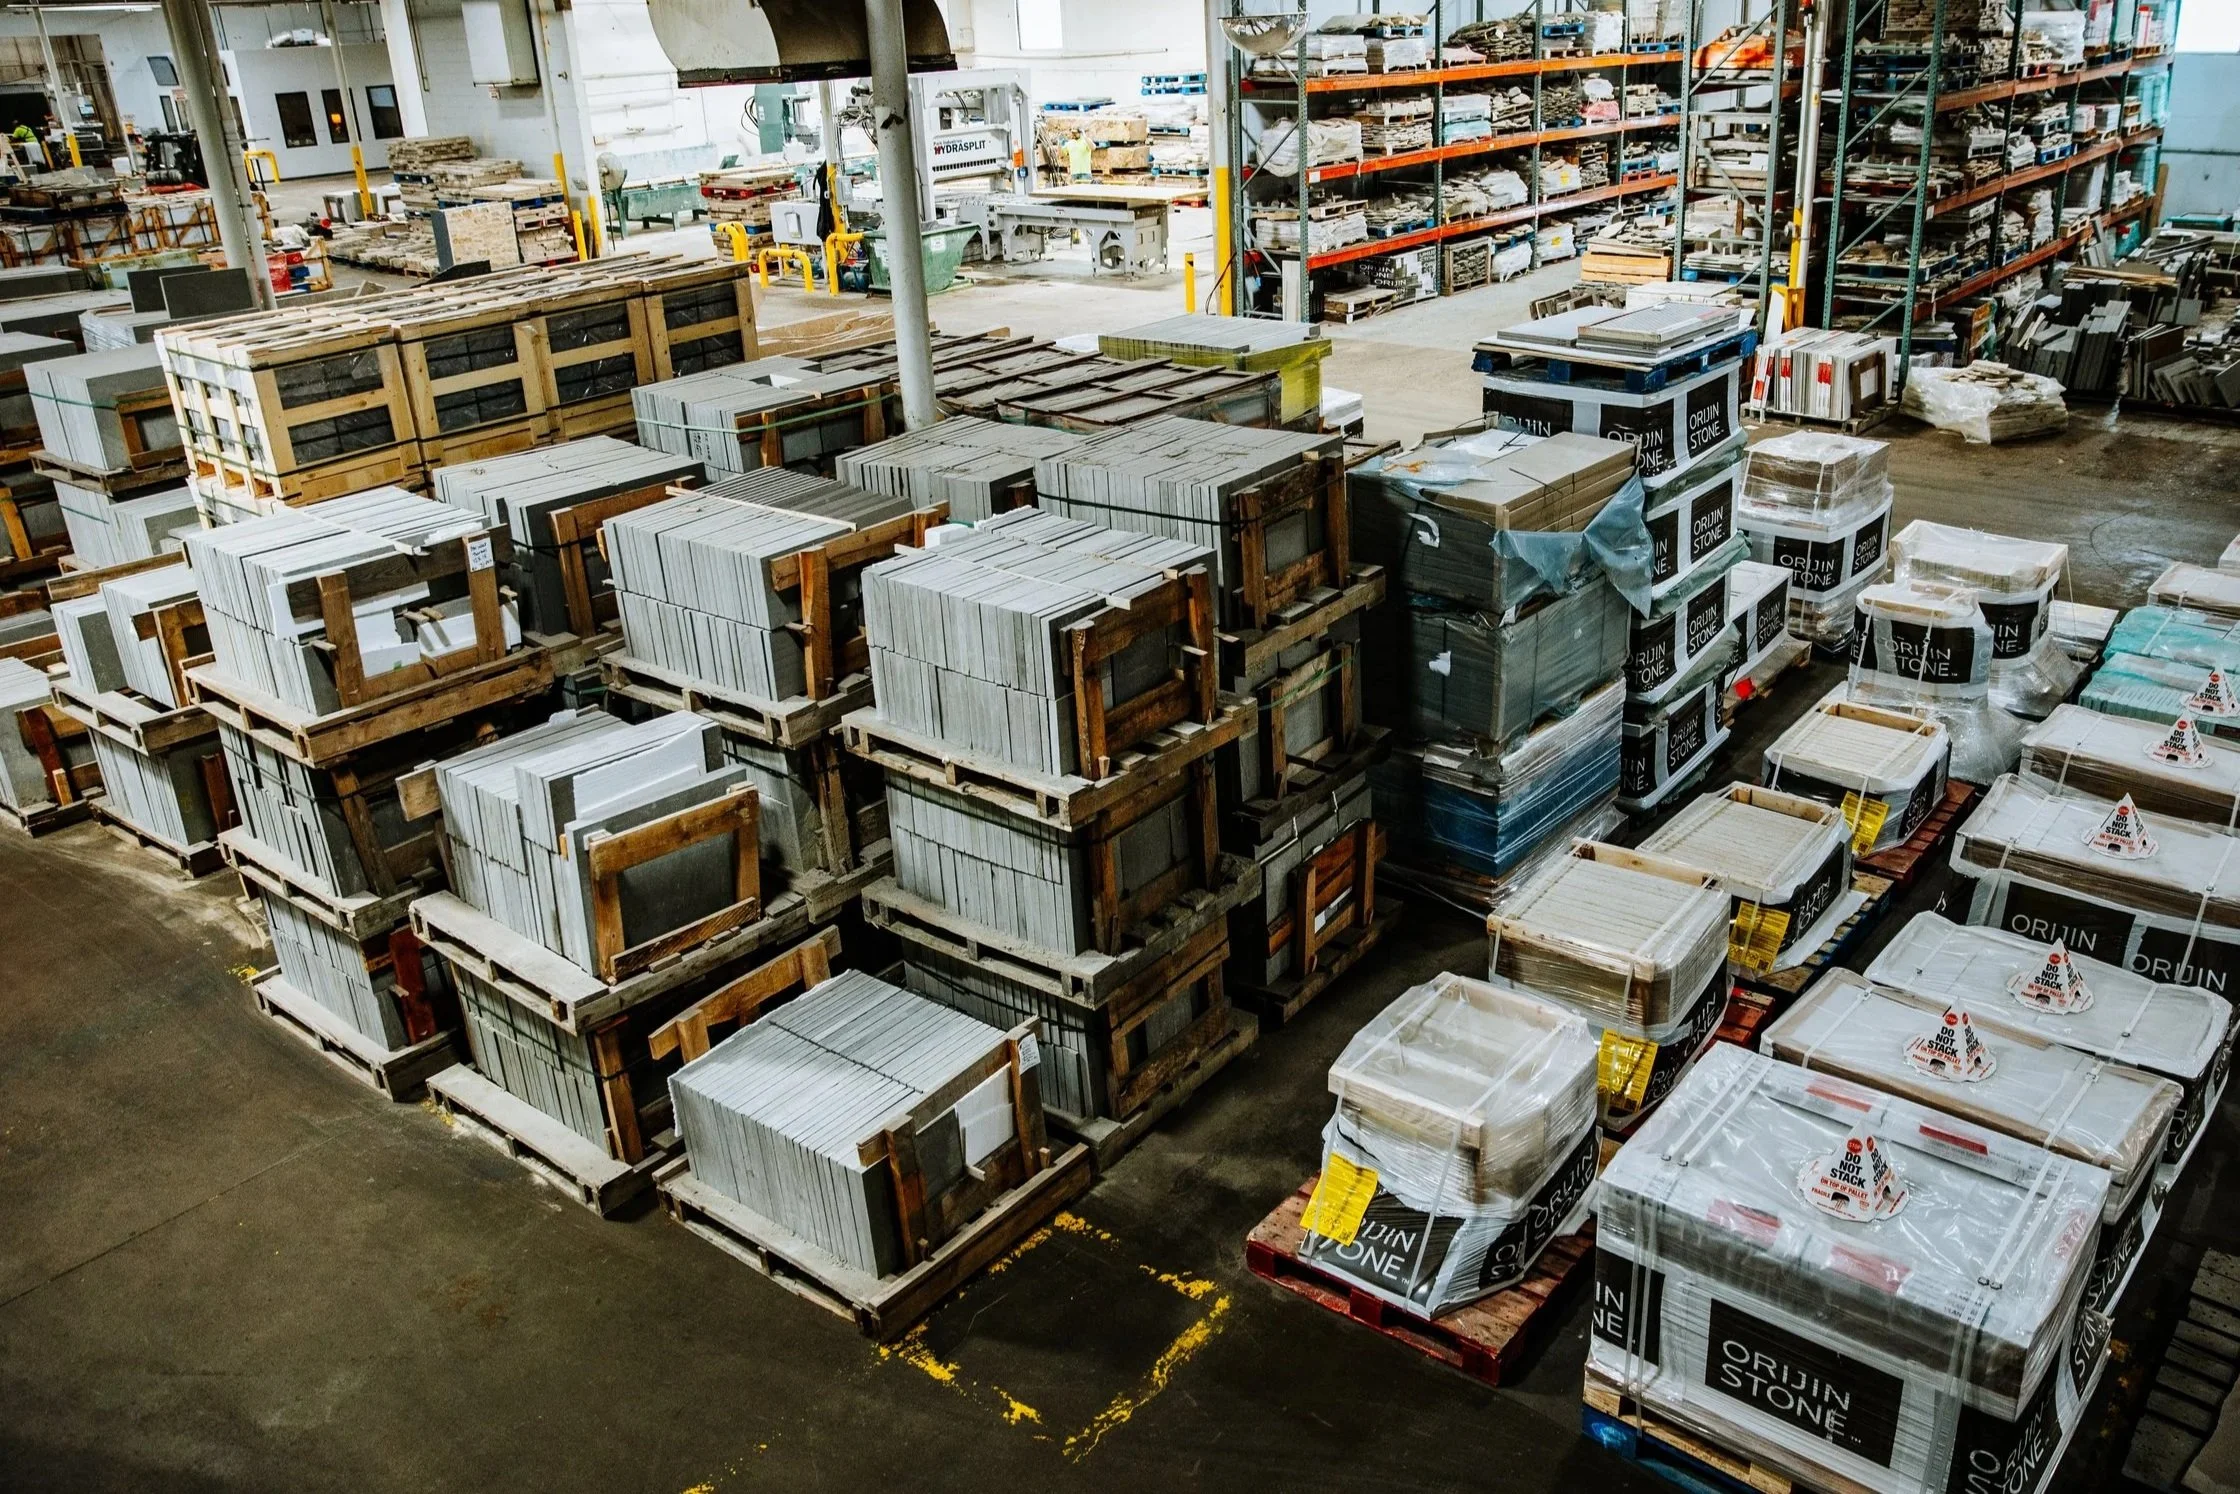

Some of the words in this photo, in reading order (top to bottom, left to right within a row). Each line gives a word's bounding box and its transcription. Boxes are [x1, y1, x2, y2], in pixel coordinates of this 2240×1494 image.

[934, 140, 986, 155] HYDRASPLIT
[1689, 401, 1719, 430] ORIJIN
[1690, 423, 1720, 450] STONE
[1694, 505, 1724, 535] ORIJIN
[1693, 523, 1723, 554] STONE
[1857, 533, 1877, 556] ORIJIN
[1792, 571, 1832, 586] TONE
[1689, 604, 1717, 635] ORIJIN
[1689, 617, 1718, 654] STONE
[2200, 692, 2222, 703] STACK
[1670, 734, 1699, 767] STONE
[2164, 740, 2188, 752] STACK
[2112, 821, 2129, 830] NOT
[2116, 814, 2127, 823] DO
[2105, 826, 2131, 838] STACK
[2011, 914, 2097, 951] ORIJIN
[2041, 970, 2060, 981] NOT
[2045, 963, 2059, 973] DO
[2034, 976, 2063, 991] STACK
[1940, 1026, 1955, 1037] DO
[1928, 1040, 1958, 1057] STACK
[1936, 1034, 1956, 1047] NOT
[1845, 1151, 1861, 1165] DO
[1839, 1160, 1862, 1176] NOT
[1830, 1168, 1866, 1189] STACK
[1820, 1178, 1828, 1186] ON
[1828, 1180, 1839, 1188] TOP
[1839, 1183, 1847, 1191] OF
[1848, 1186, 1868, 1199] PALLET
[1722, 1340, 1851, 1412] ORIJIN
[1720, 1363, 1848, 1438] STONE
